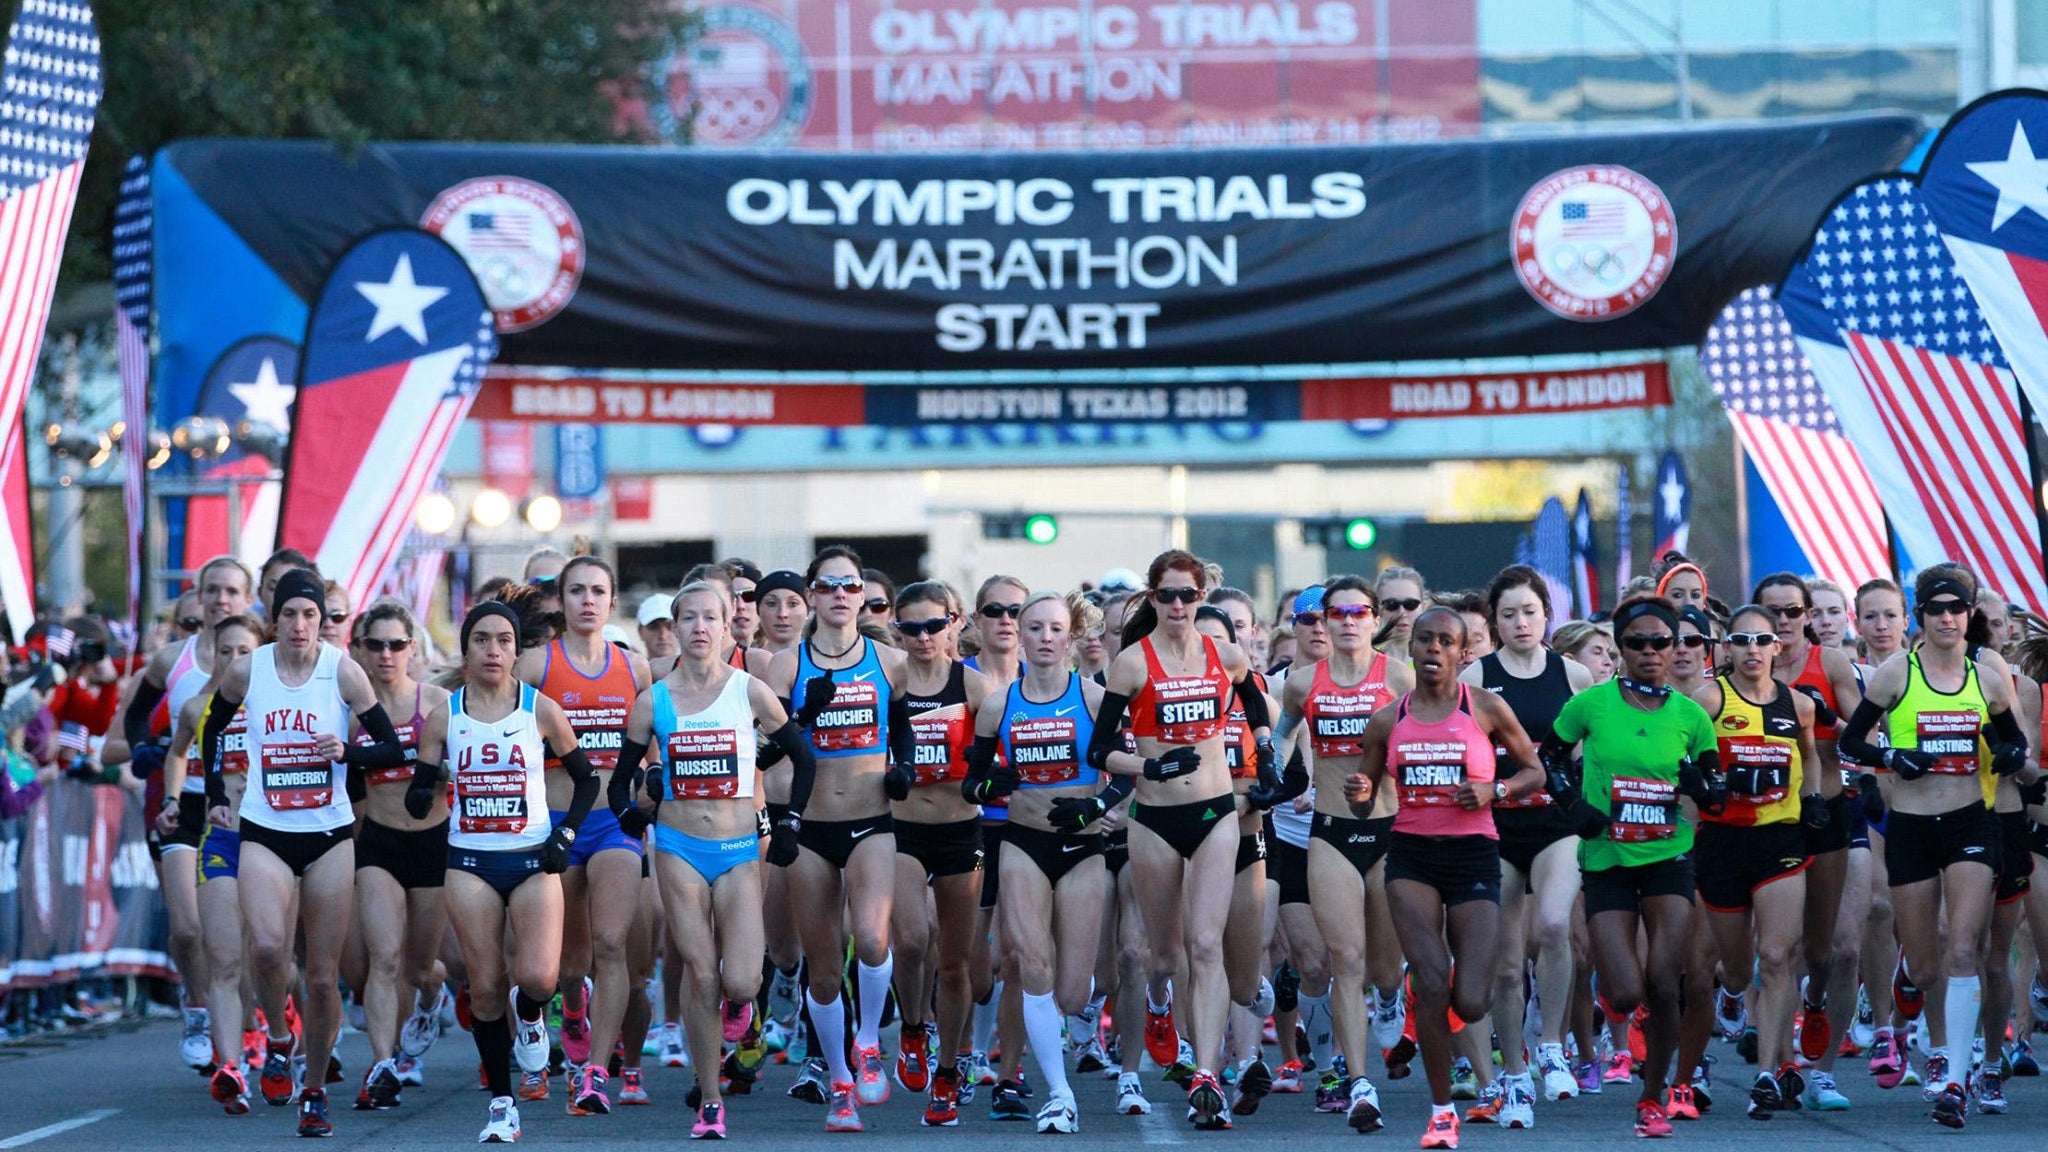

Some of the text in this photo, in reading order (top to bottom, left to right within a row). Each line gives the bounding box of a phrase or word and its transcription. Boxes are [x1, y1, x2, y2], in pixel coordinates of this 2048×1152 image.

[871, 1, 1360, 54] OLYMPIC TRIALS
[874, 57, 1182, 106] MARATHON
[726, 172, 1367, 226] OLYMPIC TRIALS
[833, 235, 1238, 290] MARATHON
[935, 302, 1161, 352] START
[511, 385, 776, 420] ROAD TO LONDON
[917, 386, 1248, 420] HOUSTON TEXAS 2012
[1390, 371, 1647, 413] ROAD TO LONDON
[265, 708, 317, 736] NYAC
[816, 708, 874, 728] GOUCHER
[1163, 700, 1215, 724] STEPH
[685, 720, 720, 729] Reebok
[1318, 718, 1369, 735] NELSON
[457, 743, 526, 771] USA
[1015, 744, 1071, 763] SHALANE
[1922, 739, 1974, 753] HASTINGS
[266, 771, 328, 787] NEWBERRY
[675, 759, 731, 776] RUSSELL
[1404, 765, 1461, 786] ASFAW
[465, 797, 522, 818] GOMEZ
[1620, 803, 1667, 825] AKOR
[1357, 834, 1377, 843] asics
